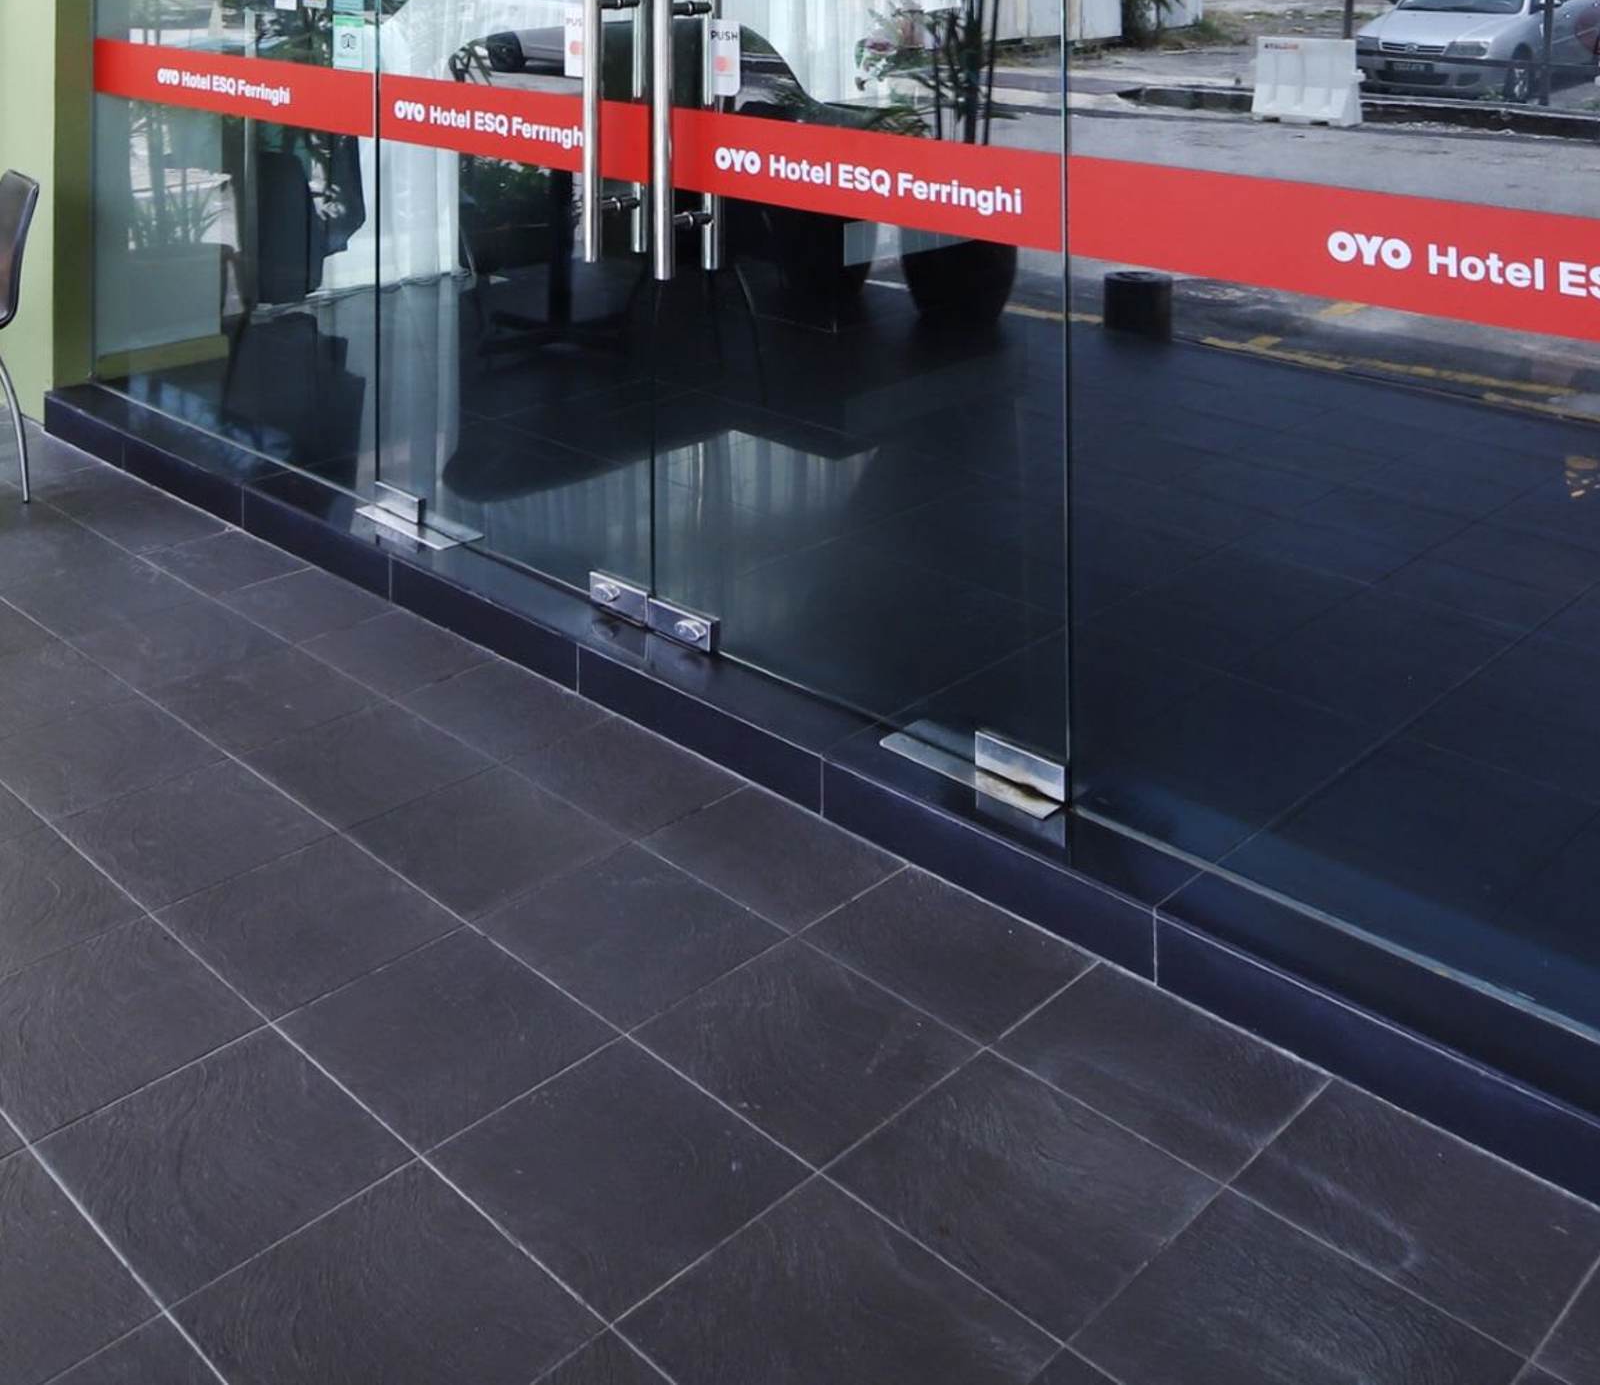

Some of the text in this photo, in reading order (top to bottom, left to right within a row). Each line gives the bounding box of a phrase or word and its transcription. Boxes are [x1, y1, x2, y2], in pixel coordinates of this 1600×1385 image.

[565, 17, 584, 27] PUS
[710, 30, 739, 41] PUSH
[156, 68, 291, 107] OYO Hotel ESQ Ferringhi
[394, 99, 584, 149] OYO Hotel ESQ Ferringh
[714, 146, 1023, 216] OYO Hotel ESQ Ferringhi
[1327, 230, 1412, 270] OYO
[1427, 243, 1545, 291] Hotel
